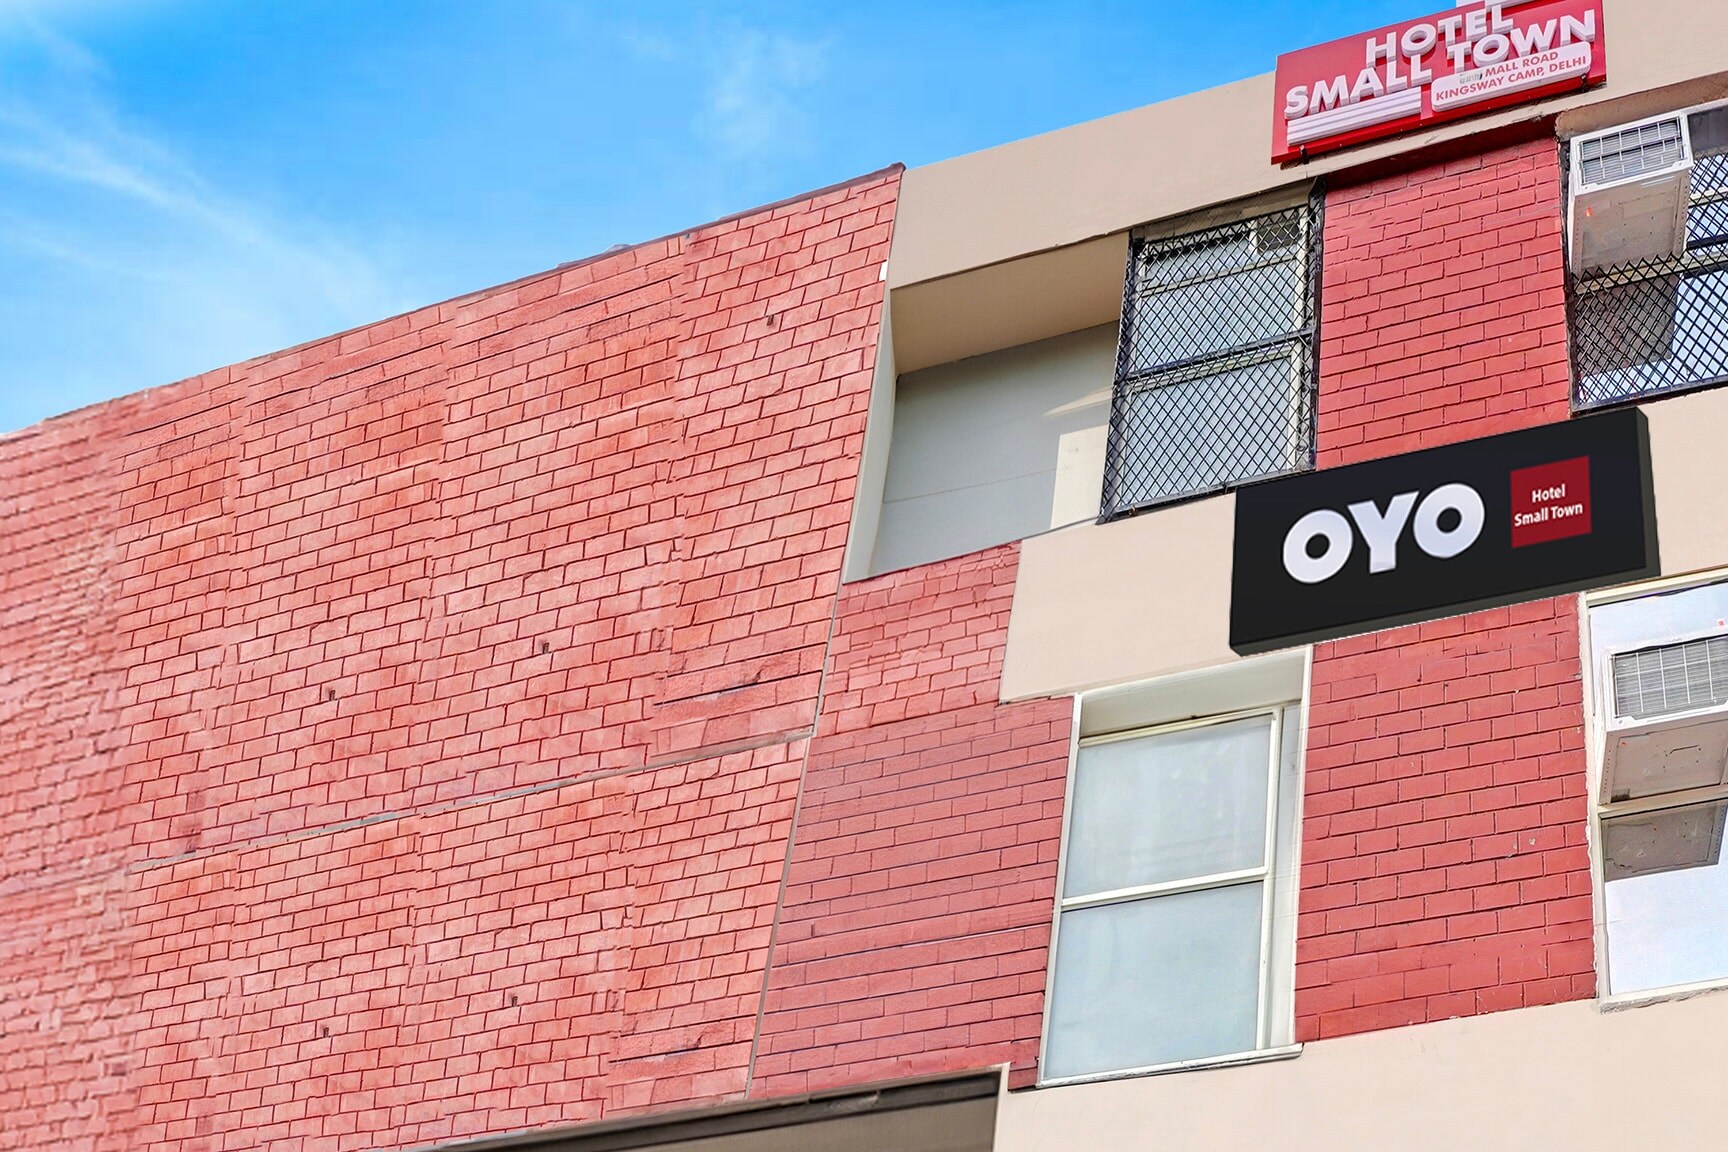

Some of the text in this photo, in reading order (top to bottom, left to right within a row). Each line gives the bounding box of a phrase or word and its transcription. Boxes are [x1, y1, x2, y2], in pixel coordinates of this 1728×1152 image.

[1366, 4, 1514, 68] HOTEL
[1284, 9, 1595, 119] SMALL TOWN
[1436, 76, 1505, 101] KINGSWAY
[1508, 67, 1545, 83] CAMP,
[1549, 56, 1587, 73] DELHI
[1485, 62, 1518, 77] MALL
[1522, 51, 1559, 68] ROAD
[1514, 503, 1583, 527] Small Town
[1532, 483, 1566, 503] Hotel
[1282, 482, 1486, 584] OYO
